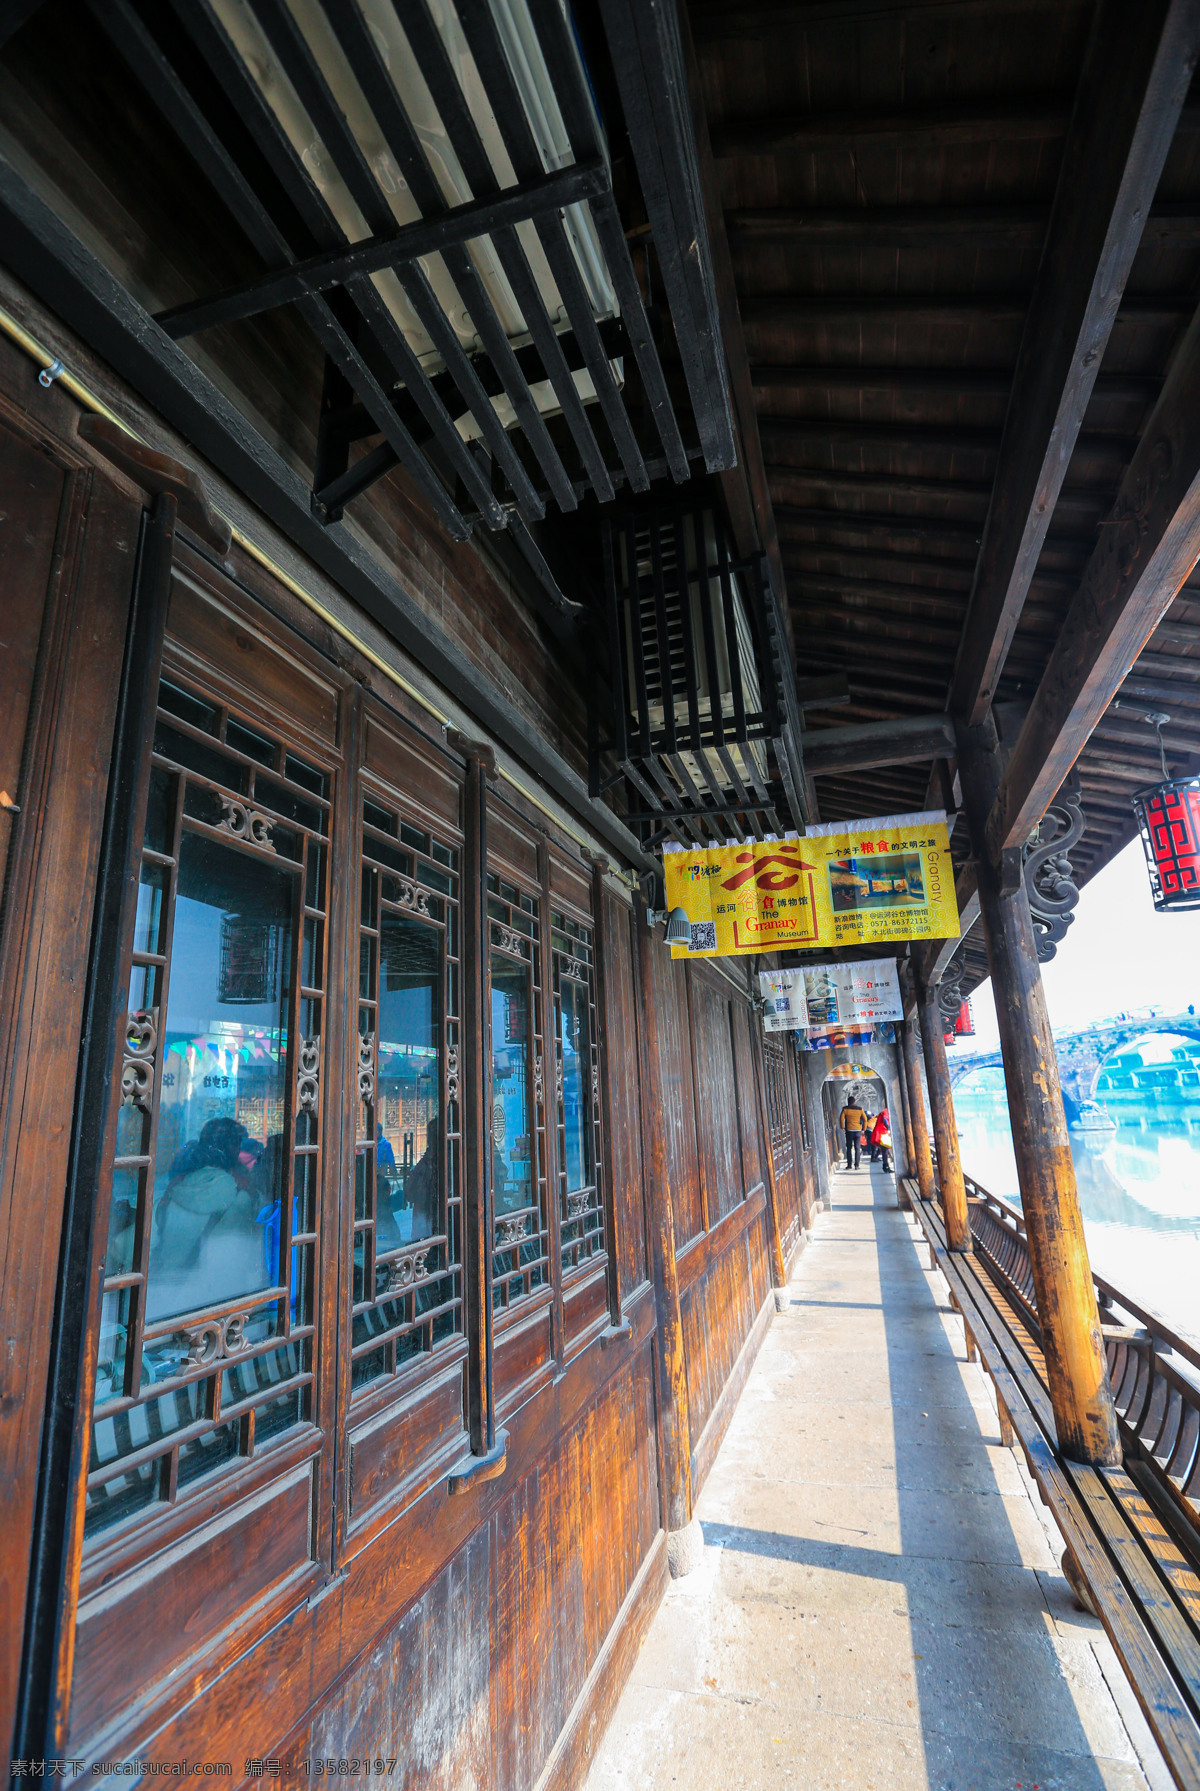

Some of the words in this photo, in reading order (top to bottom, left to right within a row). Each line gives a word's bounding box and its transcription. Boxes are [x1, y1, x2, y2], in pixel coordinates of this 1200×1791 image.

[825, 839, 937, 857] 一个关于粮食的文明之旅
[927, 851, 942, 903] Granary
[761, 911, 780, 920] The
[745, 917, 798, 931] Granary
[870, 917, 928, 927] 0571-86372115
[777, 930, 809, 938] Museum
